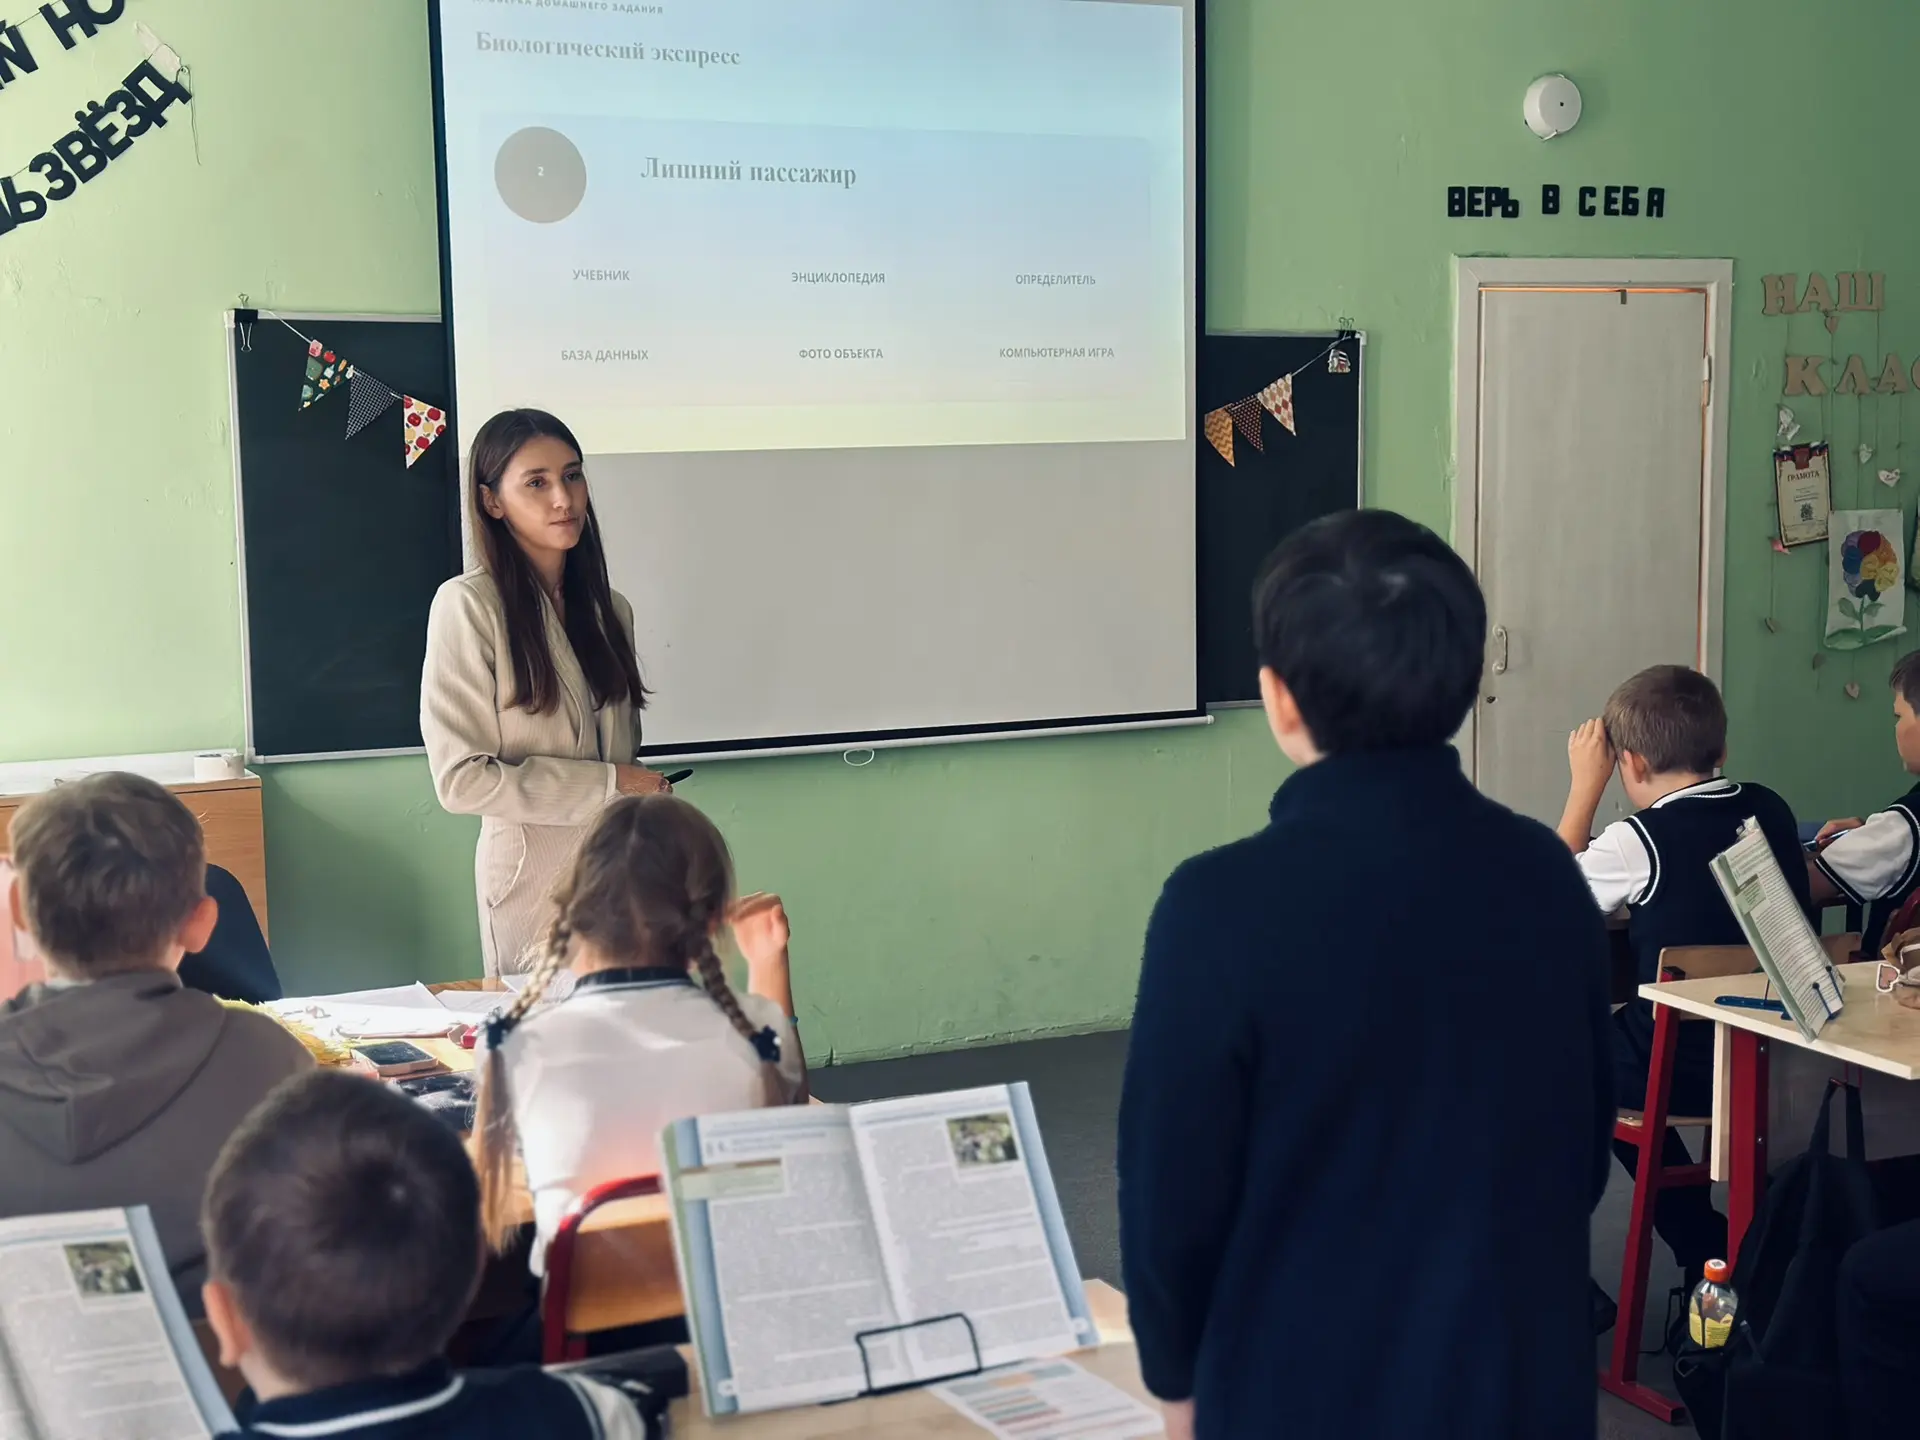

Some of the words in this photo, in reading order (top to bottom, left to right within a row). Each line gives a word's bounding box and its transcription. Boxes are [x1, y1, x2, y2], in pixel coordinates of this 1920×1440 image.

[612, 3, 664, 15] ЗАДАНИЯ
[475, 31, 645, 60] Биологический
[651, 47, 741, 68] экспресс
[537, 166, 545, 176] 2
[640, 156, 742, 180] Лишний
[750, 164, 857, 189] пассажир
[1447, 186, 1519, 218] ВЕРЬ
[1542, 184, 1560, 215] В
[1579, 185, 1665, 218] СЕБЯ
[572, 269, 630, 281] УЧЕБНИК
[791, 271, 886, 286] ЭНЦИКЛОПЕДИЯ
[1015, 274, 1096, 287] ОПРЕДЕЛИТЕЛЬ
[1761, 271, 1885, 316] НАШ
[561, 349, 593, 361] БАЗА
[595, 349, 649, 363] ДАННЫХ
[798, 347, 832, 359] ФОТО
[834, 347, 884, 360] ОБЪЕКТА
[999, 347, 1086, 359] КОМПЬЮТЕРНАЯ
[1088, 347, 1115, 358] ИГРА
[1783, 353, 1920, 397] КЛА
[1787, 470, 1820, 482] ГРАМОТА
